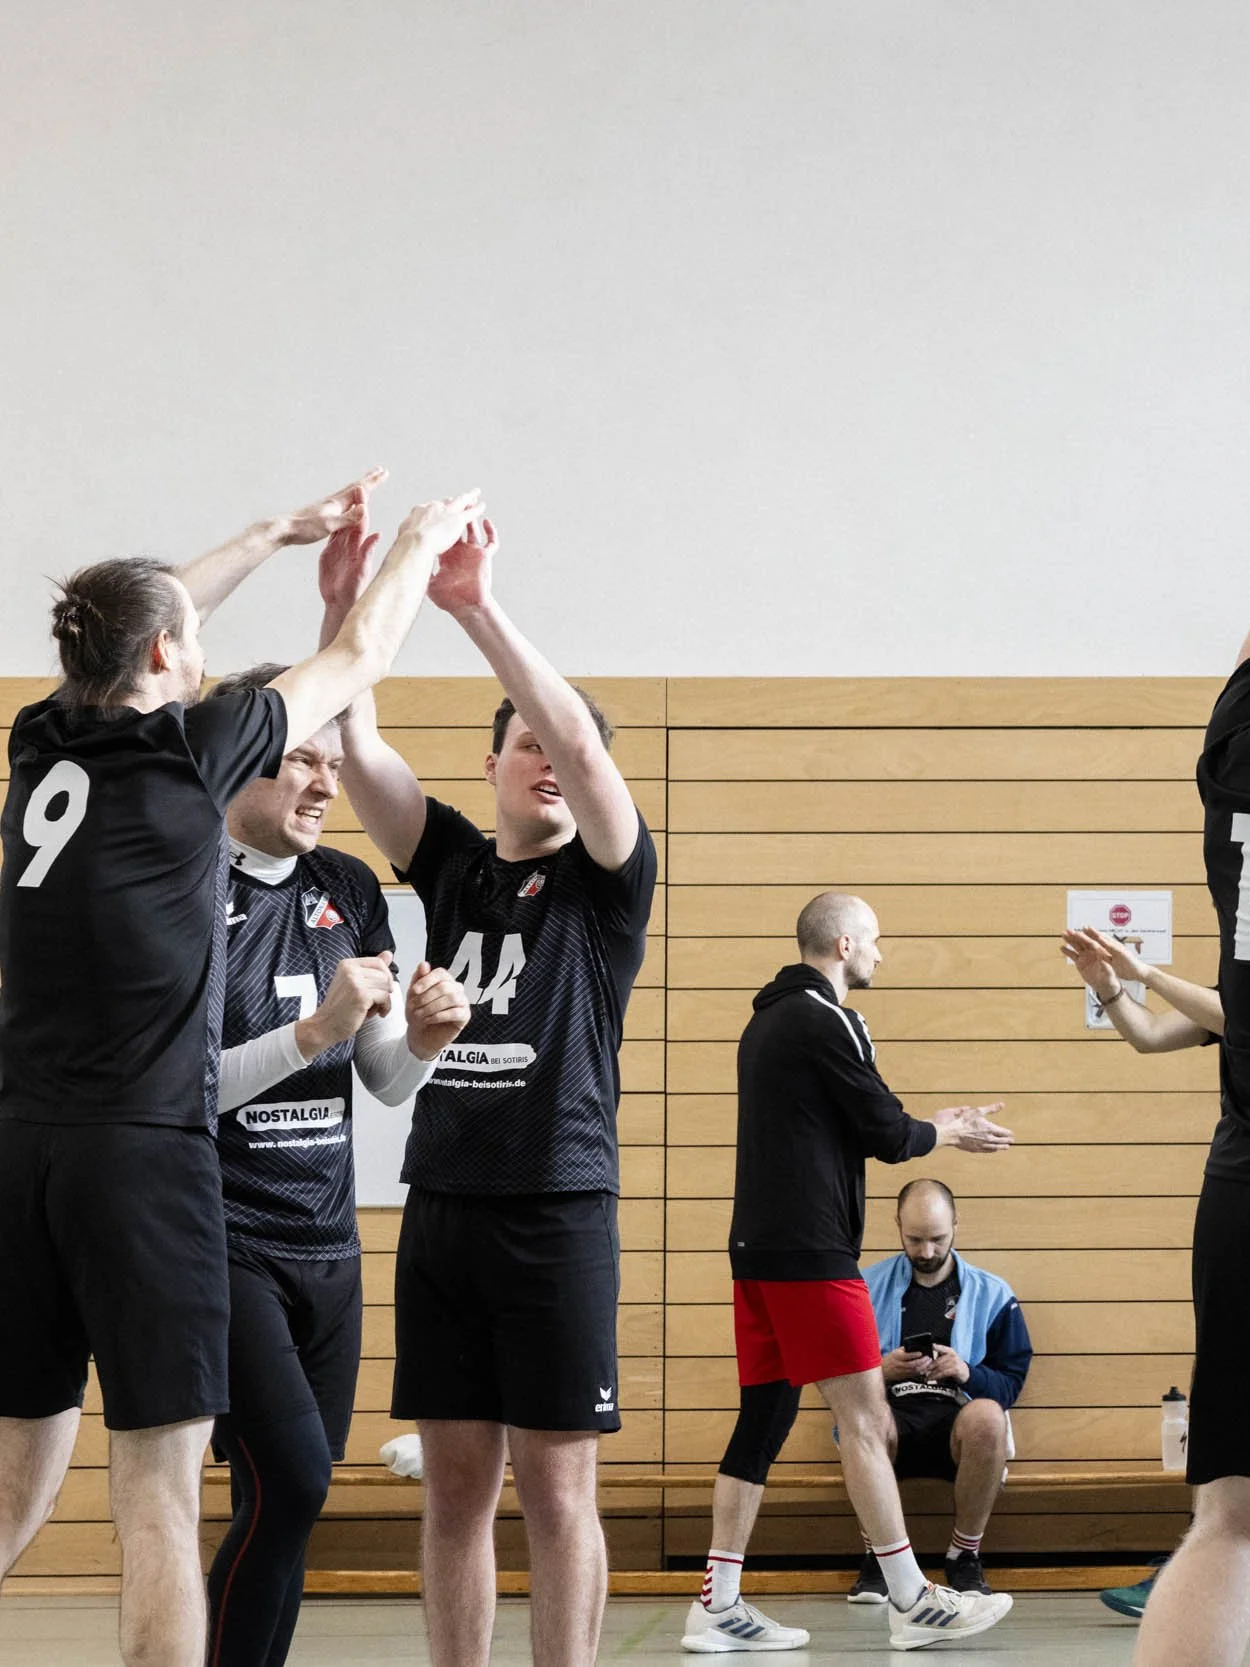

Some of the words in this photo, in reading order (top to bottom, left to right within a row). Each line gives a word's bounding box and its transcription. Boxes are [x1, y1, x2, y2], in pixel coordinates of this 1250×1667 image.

[16, 760, 90, 887] 9
[274, 973, 318, 1022] 7
[449, 931, 526, 1014] 44
[245, 1107, 329, 1124] NOSTALGIA
